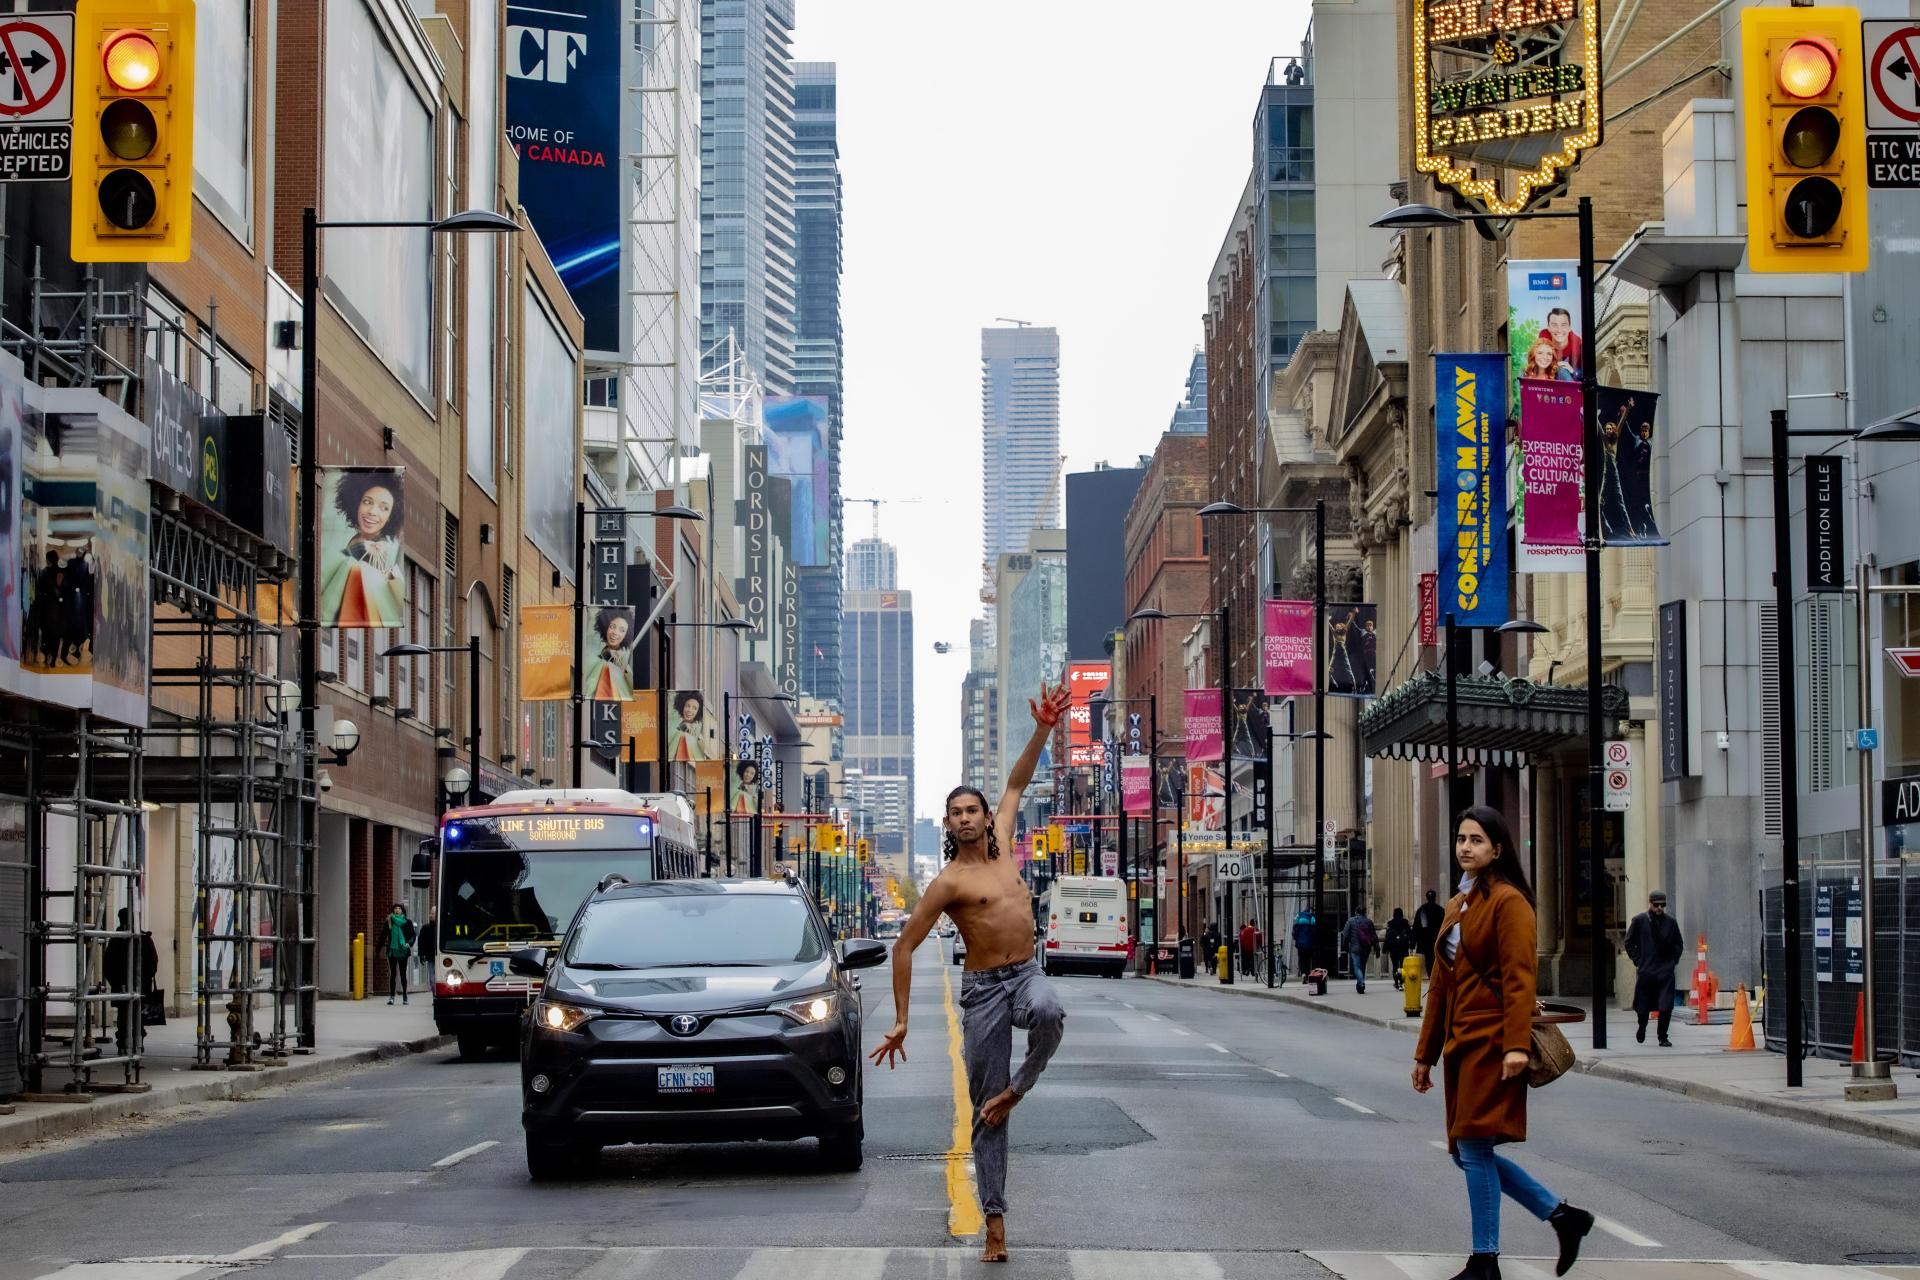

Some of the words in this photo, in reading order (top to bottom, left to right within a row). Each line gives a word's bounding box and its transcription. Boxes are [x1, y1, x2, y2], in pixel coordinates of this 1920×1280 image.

[506, 25, 587, 84] CF
[1433, 63, 1583, 110] WINTER
[1432, 100, 1584, 147] GARDEN
[1, 132, 69, 150] VEHICLES
[554, 130, 575, 144] OF
[528, 145, 605, 168] CANADA
[1869, 141, 1899, 159] TTC
[0, 154, 63, 172] EPTED
[1875, 164, 1920, 182] EXCE
[1455, 366, 1477, 443] AWAY
[1481, 412, 1489, 445] STORY
[154, 407, 183, 473] GATE
[184, 430, 192, 479] 3
[1522, 440, 1581, 456] EXPERIENCE
[1481, 446, 1490, 472] TRUE
[1529, 468, 1581, 484] CULTURAL
[1818, 464, 1831, 503] ELLE
[1525, 482, 1557, 495] HEART
[1482, 475, 1490, 550] REMARKABLE
[748, 451, 764, 634] NORDSTROM
[1819, 507, 1831, 583] ADDITION
[1457, 530, 1478, 611] COME
[1482, 550, 1490, 567] THE
[1423, 576, 1432, 641] HOMESENSE
[785, 564, 797, 709] NORDSTROM
[1264, 635, 1313, 645] EXPERIENCE
[1666, 609, 1674, 660] ELLE
[1264, 643, 1312, 652] TORONTO'S
[1270, 652, 1313, 660] CULTURAL
[1667, 669, 1675, 773] ADDITION
[1256, 780, 1265, 822] PUB
[501, 820, 525, 832] LINE
[528, 820, 534, 831] 1
[536, 818, 581, 831] SHUTTLE
[584, 818, 605, 830] BUS
[529, 830, 577, 841] SOUTHBOUND
[1188, 833, 1214, 842] Yonge
[1215, 833, 1240, 841] Sues
[1219, 862, 1240, 877] 40
